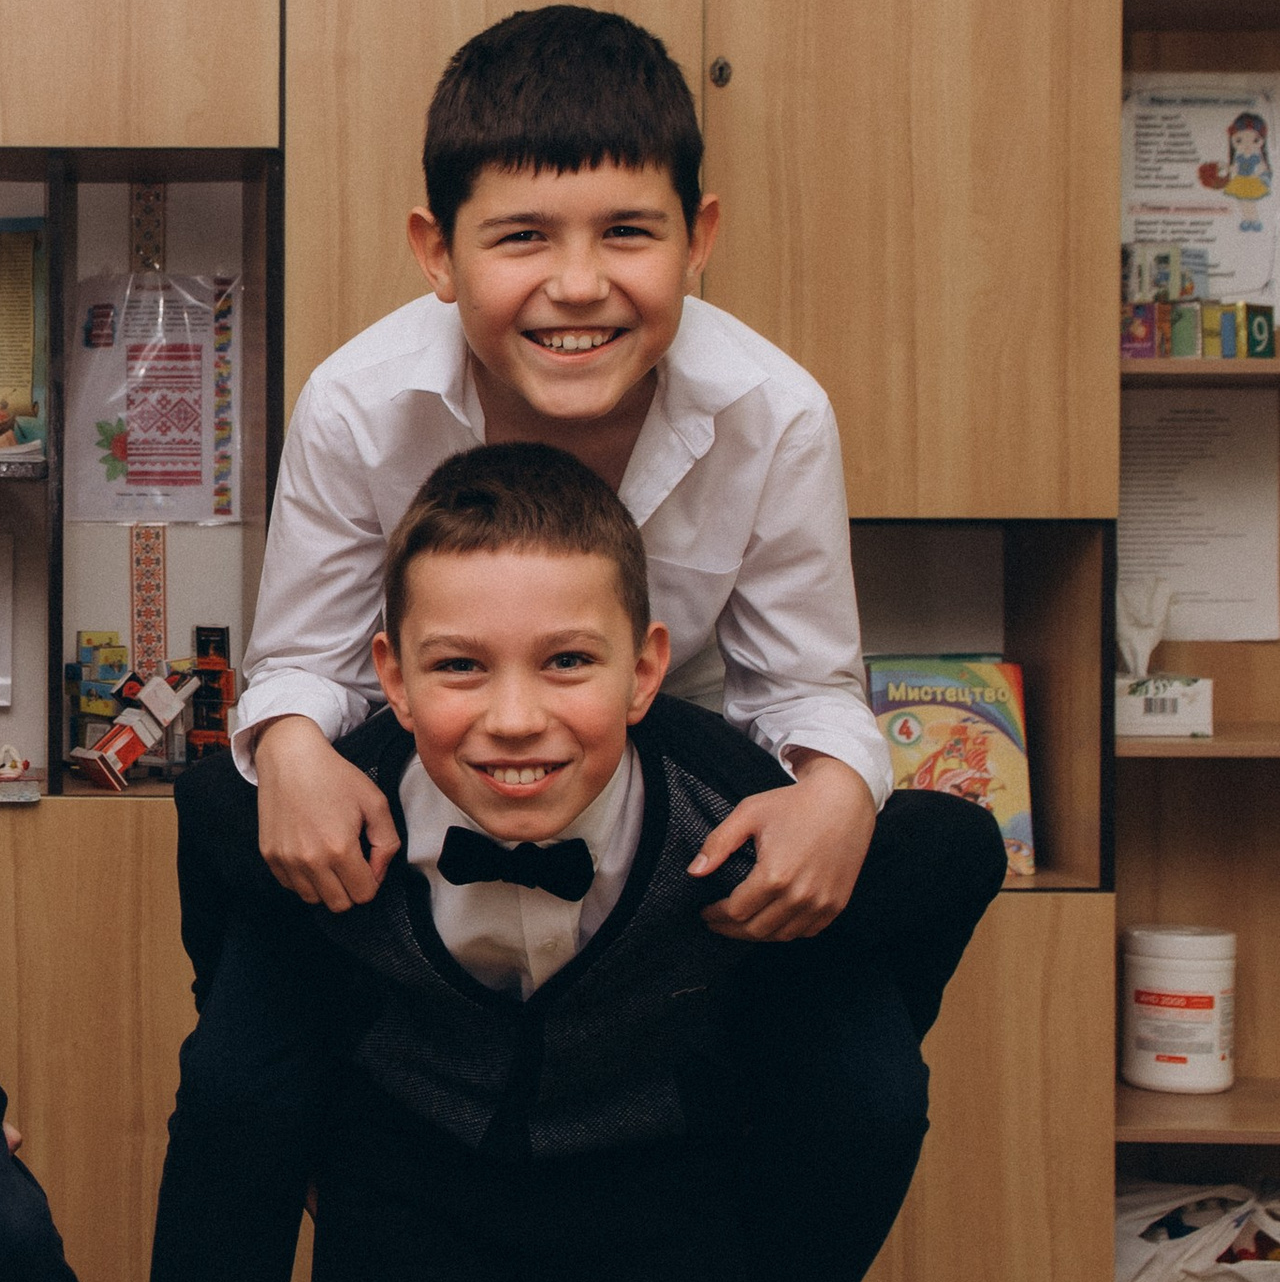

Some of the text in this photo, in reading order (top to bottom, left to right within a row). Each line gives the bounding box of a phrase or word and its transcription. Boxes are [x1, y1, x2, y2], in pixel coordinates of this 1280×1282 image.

[1251, 315, 1270, 353] 9
[887, 681, 1010, 706] Мистецтво
[898, 718, 913, 739] 4
